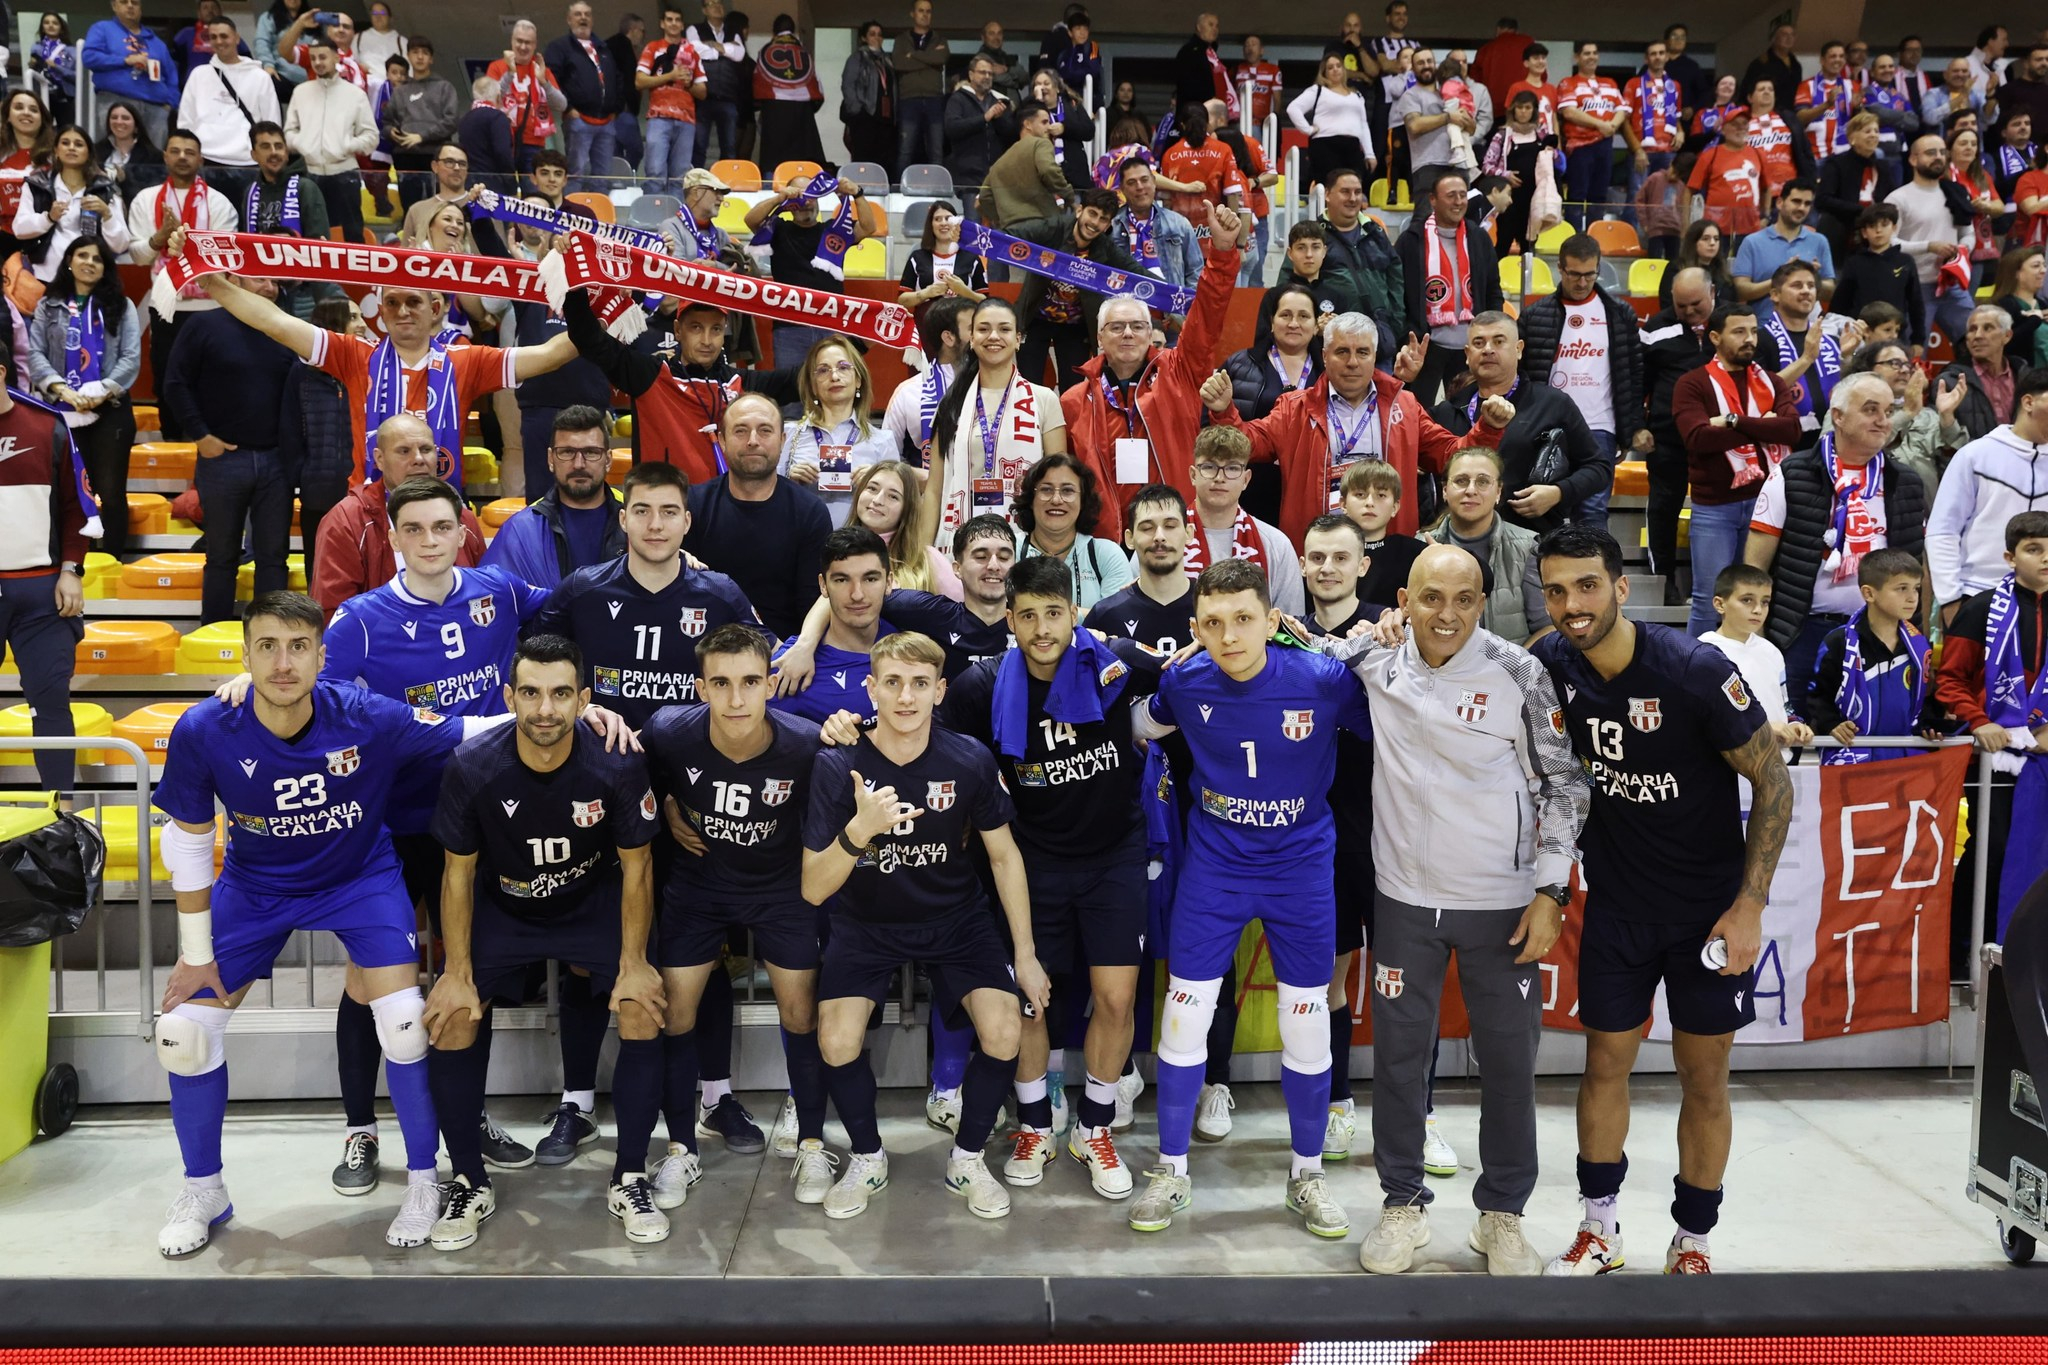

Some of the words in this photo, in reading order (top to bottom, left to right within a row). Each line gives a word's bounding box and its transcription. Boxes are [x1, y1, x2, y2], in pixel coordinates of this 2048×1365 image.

[1170, 150, 1222, 161] CARTAGENA
[502, 196, 556, 223] WHITE
[557, 212, 594, 234] AND
[597, 221, 638, 245] BLUE
[253, 242, 397, 273] UNITED
[1070, 260, 1097, 275] FUTSAL
[642, 254, 758, 301] UNITED
[1554, 338, 1604, 364] Jimbee
[440, 622, 466, 659] 9
[633, 625, 662, 661] 11
[622, 669, 695, 685] PRIMARIA
[1039, 719, 1077, 751] 14
[1586, 717, 1624, 761] 13
[1045, 740, 1117, 773] PRIMARIA
[1240, 741, 1257, 778] 1
[273, 773, 327, 811] 23
[712, 781, 752, 817] 16
[1227, 796, 1305, 812] PRIMARIA
[268, 800, 362, 827] PRIMARIA
[704, 815, 777, 834] PRIMARIA
[526, 836, 571, 866] 10
[878, 842, 948, 860] PRIMARIA
